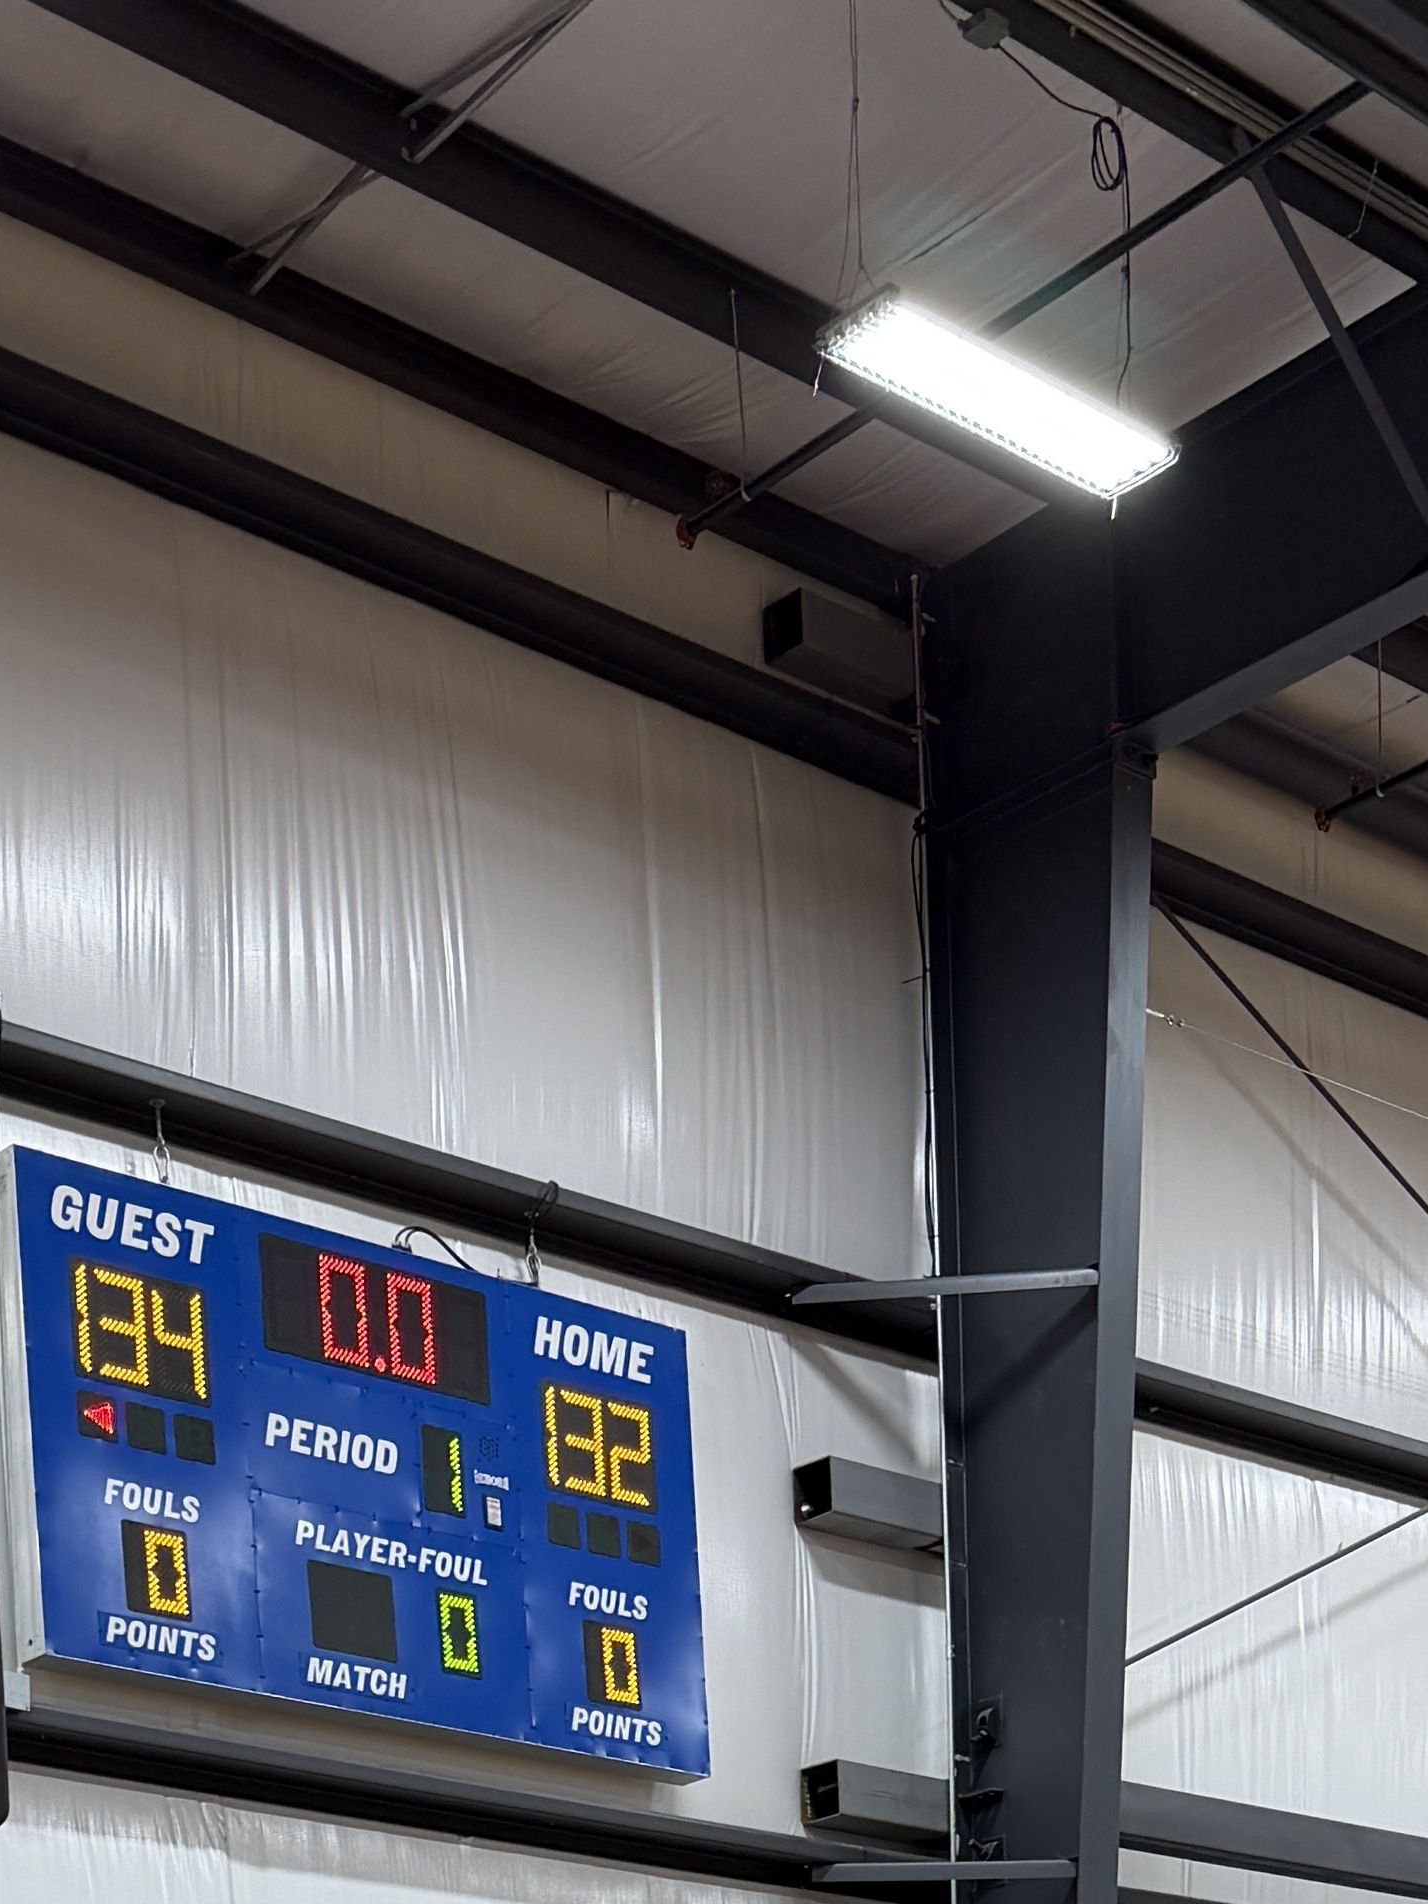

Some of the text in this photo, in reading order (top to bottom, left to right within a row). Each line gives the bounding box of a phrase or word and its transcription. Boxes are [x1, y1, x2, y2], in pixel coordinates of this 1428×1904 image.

[50, 1184, 214, 1265] GUEST
[74, 1264, 207, 1400] 134
[319, 1253, 437, 1386] 0.0
[533, 1315, 654, 1384] HOME
[265, 1412, 399, 1476] PERIOD
[448, 1437, 464, 1513] 1
[545, 1385, 651, 1507] 132
[103, 1477, 200, 1524] FOULS
[144, 1529, 190, 1616] 0
[295, 1519, 488, 1587] PLAYER-FOUL
[439, 1592, 479, 1674] 0
[568, 1580, 649, 1621] FOULS
[105, 1615, 217, 1662] POINTS
[601, 1626, 640, 1705] 0
[306, 1656, 408, 1700] MATCH
[571, 1706, 663, 1747] POINTS
